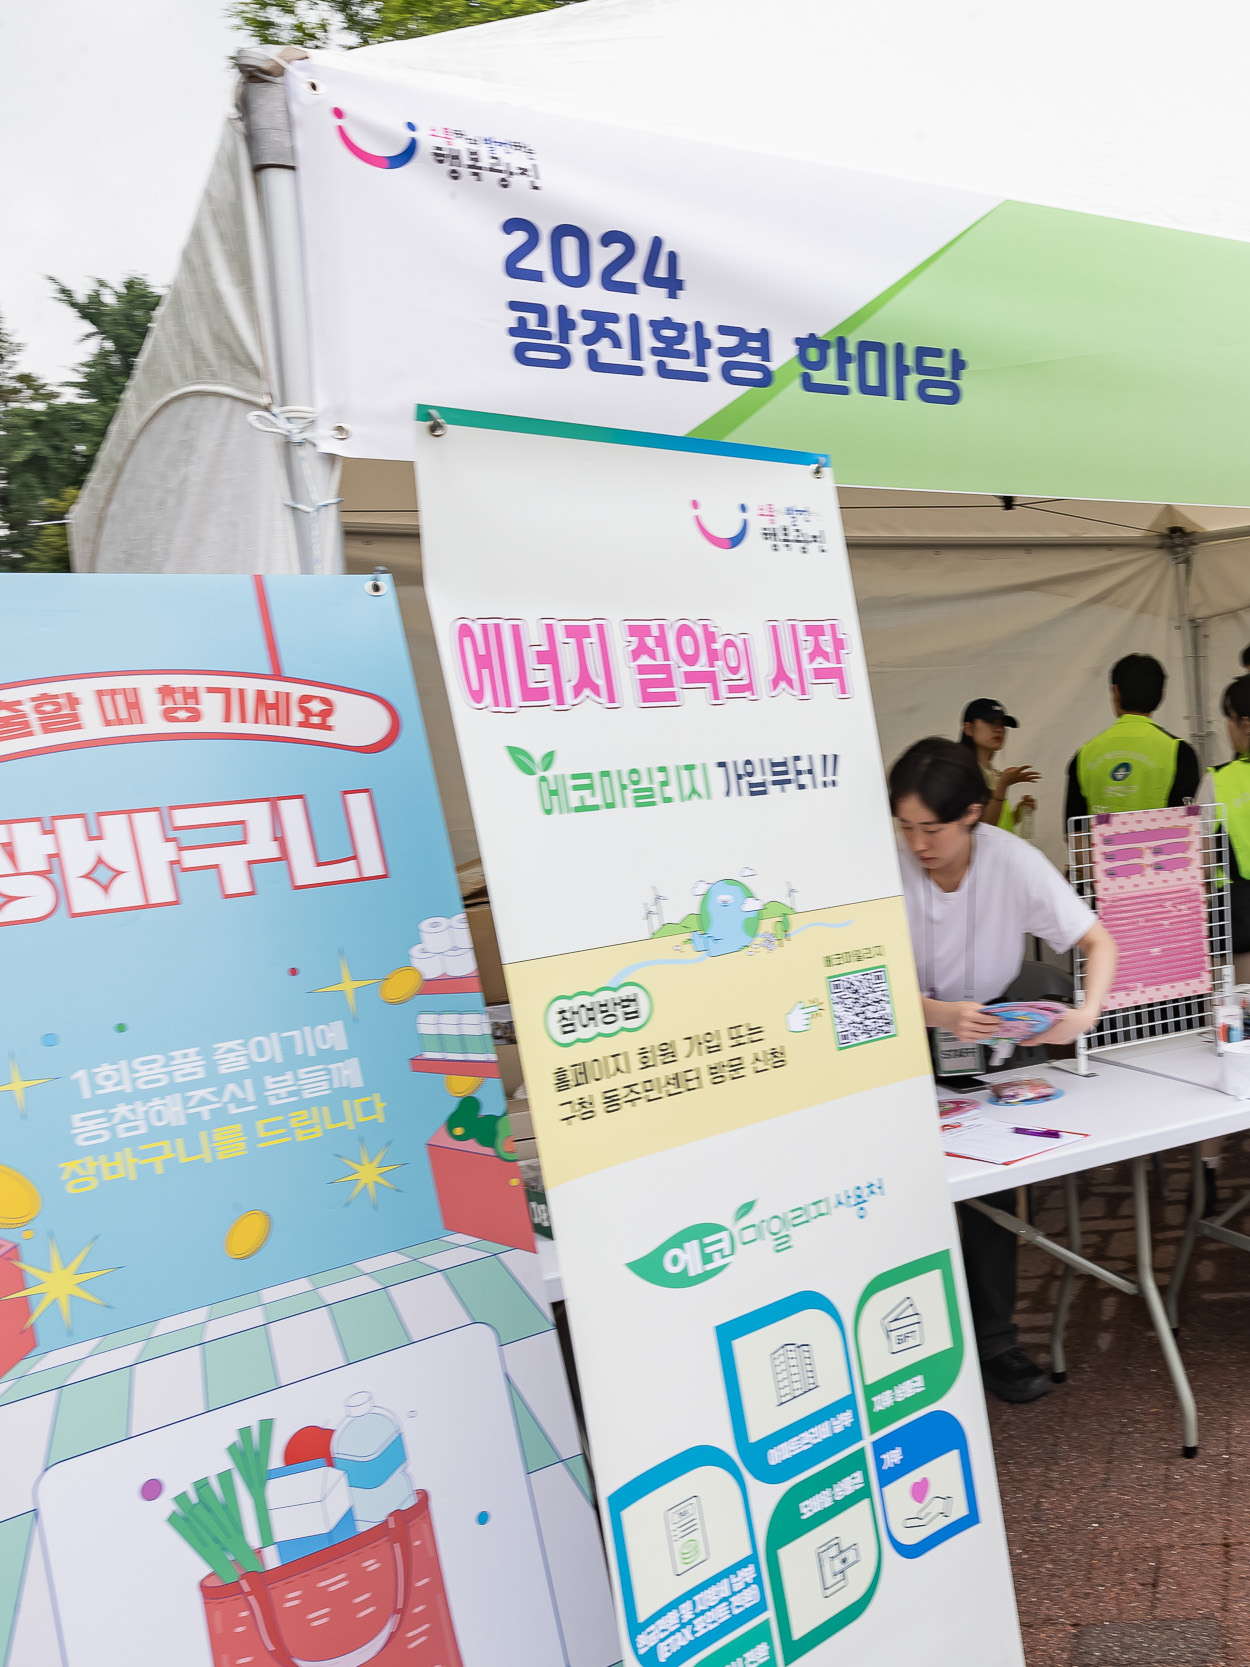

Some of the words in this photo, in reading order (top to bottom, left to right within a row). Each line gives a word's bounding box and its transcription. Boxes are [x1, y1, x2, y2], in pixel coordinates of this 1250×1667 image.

[430, 145, 543, 191] 행복광진
[501, 217, 685, 300] 2024
[507, 299, 774, 390] 광진환경
[794, 332, 967, 406] 한마당
[451, 616, 622, 713] 에너지
[622, 617, 760, 707] 절약의
[764, 618, 854, 700] 시작
[94, 686, 147, 728] 때
[155, 684, 337, 732] 챙기세요
[536, 762, 713, 816] 에코마일리지
[715, 752, 842, 799] 가입부터!!
[823, 944, 886, 968] 에코마일리지
[555, 992, 641, 1036] 참여방법
[70, 1044, 206, 1099] 1회용품
[213, 1020, 348, 1074] 줄이기에
[552, 1050, 633, 1094] 홈페이지
[637, 1041, 679, 1072] 회원
[684, 1029, 724, 1060] 가입
[727, 1022, 766, 1048] 또는
[557, 1095, 597, 1126] 구청
[600, 1066, 703, 1114] 동주민센터
[708, 1056, 746, 1086] 방문
[750, 1045, 788, 1074] 신청
[69, 1076, 256, 1148] 동참해주신
[263, 1057, 364, 1105] 분들께
[57, 1119, 249, 1195] 장바구니를
[255, 1093, 388, 1147] 드립니다
